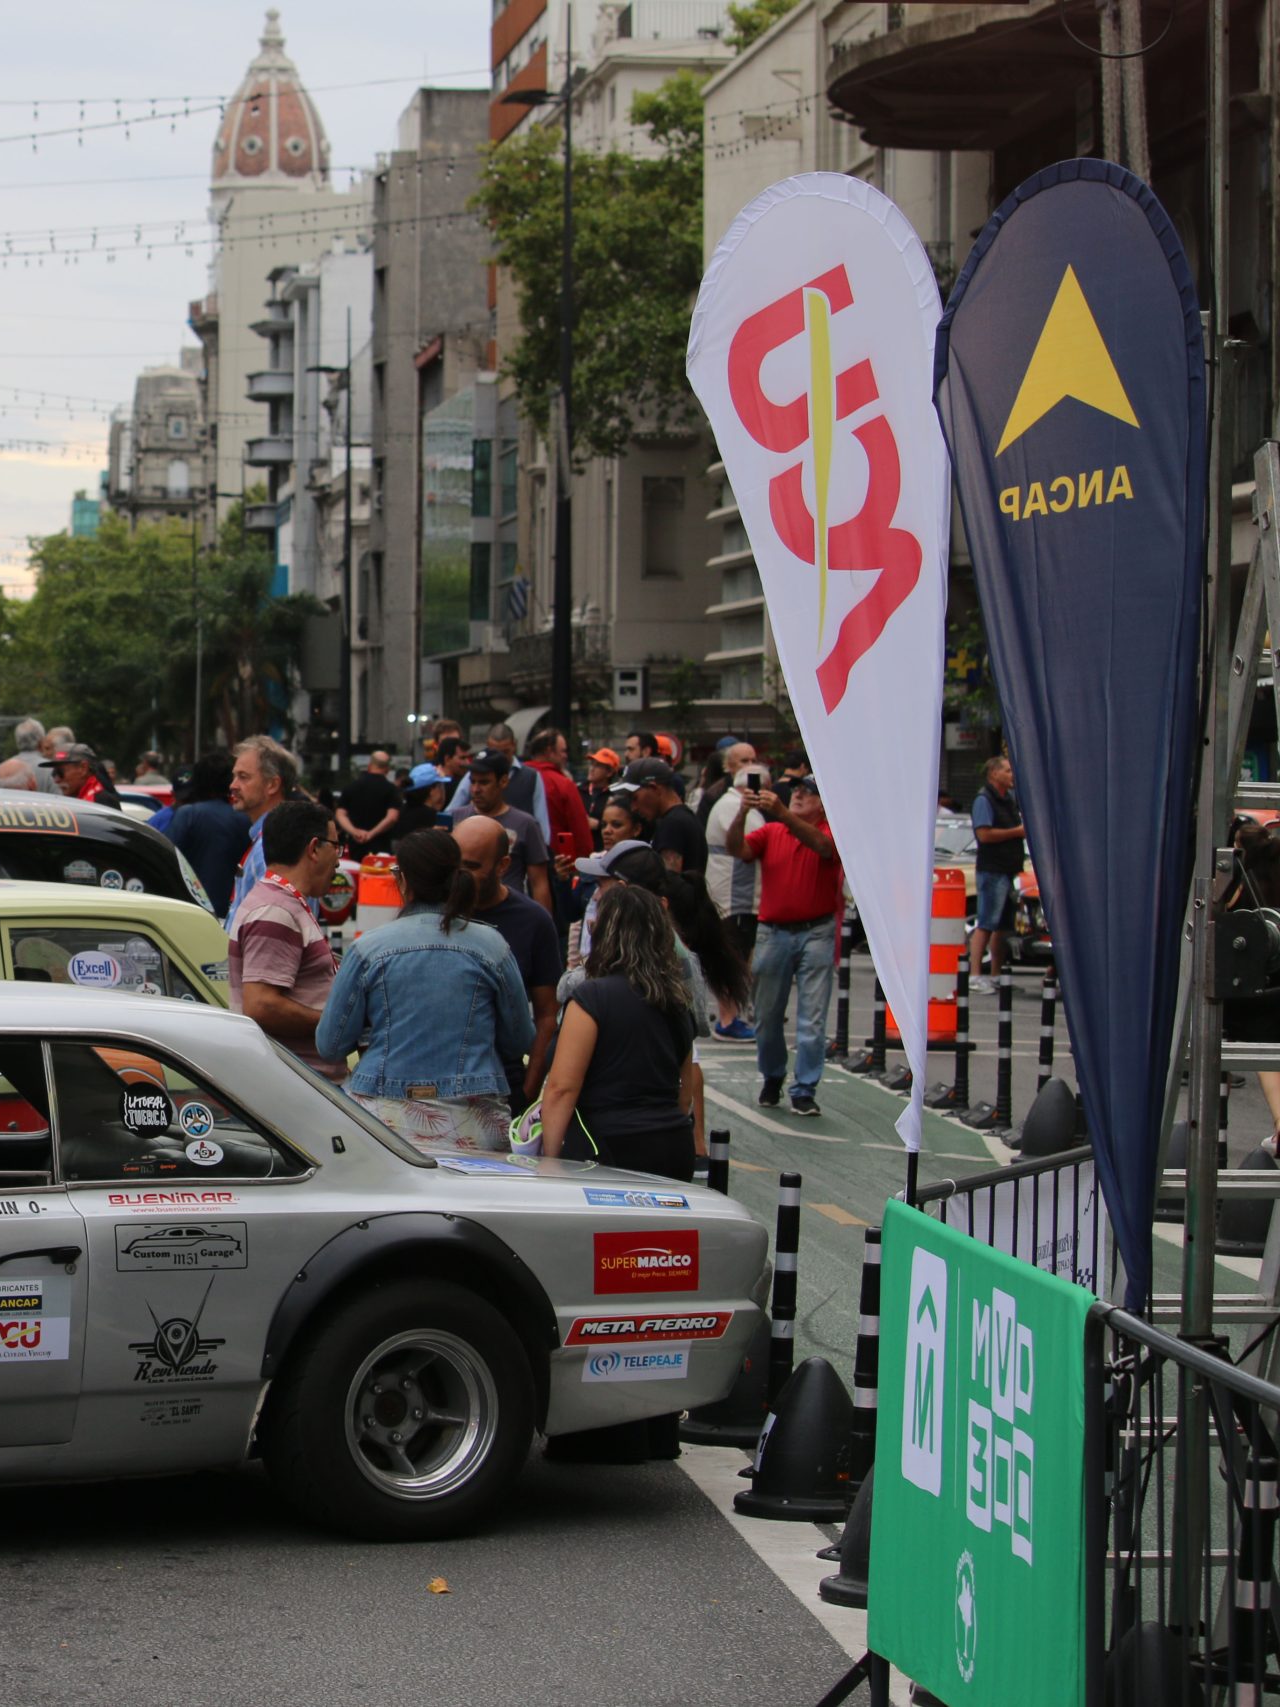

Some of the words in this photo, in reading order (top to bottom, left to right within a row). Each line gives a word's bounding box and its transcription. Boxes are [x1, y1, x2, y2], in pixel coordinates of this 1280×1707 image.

[76, 959, 112, 976] Excell
[128, 1095, 166, 1109] LITORAL
[127, 1109, 168, 1126] TUERCA
[131, 1206, 222, 1214] www.buenimar.com
[133, 1250, 171, 1259] Custom
[200, 1248, 234, 1258] Garage
[601, 1254, 691, 1270] SUPERMAGICO
[0, 1298, 39, 1308] ANCAP
[580, 1320, 636, 1335] META
[640, 1317, 718, 1332] FIERRO
[623, 1354, 683, 1367] TELEPEAJE
[971, 1290, 1034, 1416] MVD
[968, 1404, 1034, 1564] 300
